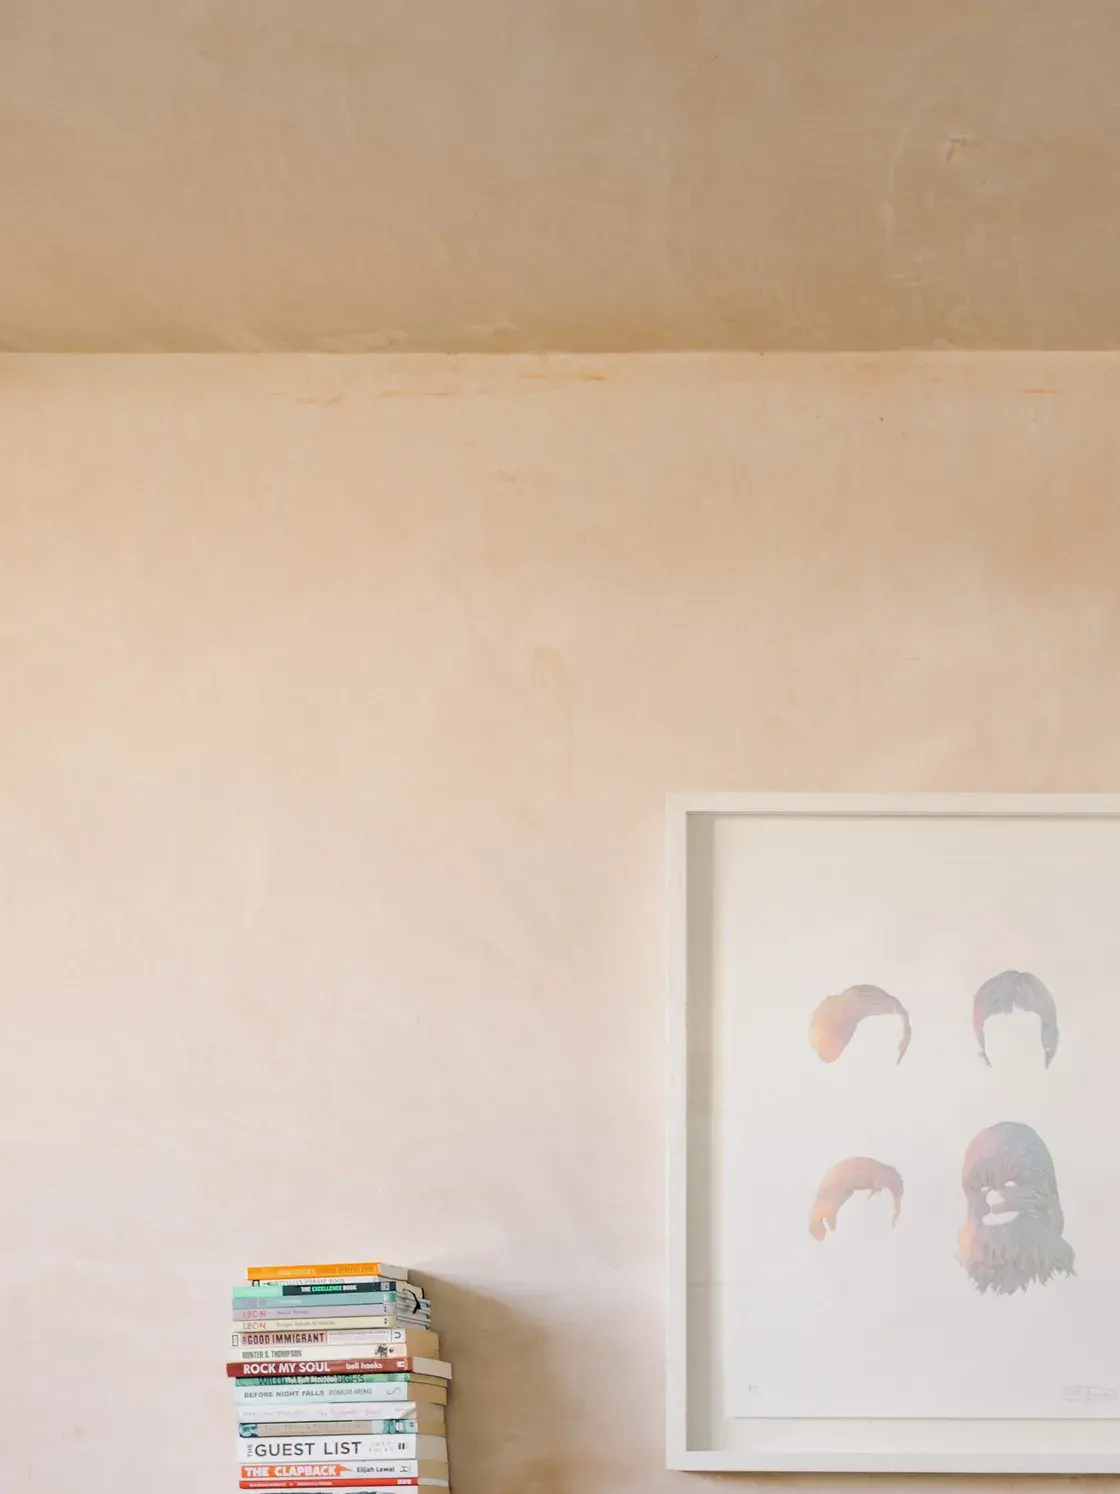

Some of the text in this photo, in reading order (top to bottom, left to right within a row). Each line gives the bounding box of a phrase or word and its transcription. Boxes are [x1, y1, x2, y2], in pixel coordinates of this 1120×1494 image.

[242, 1310, 266, 1318] LEON
[242, 1322, 266, 1330] LEON
[247, 1335, 270, 1345] GOOD
[272, 1332, 325, 1344] IMMIGRANT
[242, 1351, 263, 1359] HUNTER
[271, 1350, 302, 1358] THOMPSON
[243, 1361, 382, 1374] ROCK MY SOUL bell hooks
[301, 1389, 325, 1397] FALLS
[254, 1442, 315, 1457] GUEST
[324, 1441, 362, 1455] LIST
[244, 1466, 269, 1477] THE
[274, 1465, 337, 1477] CLAPBACK
